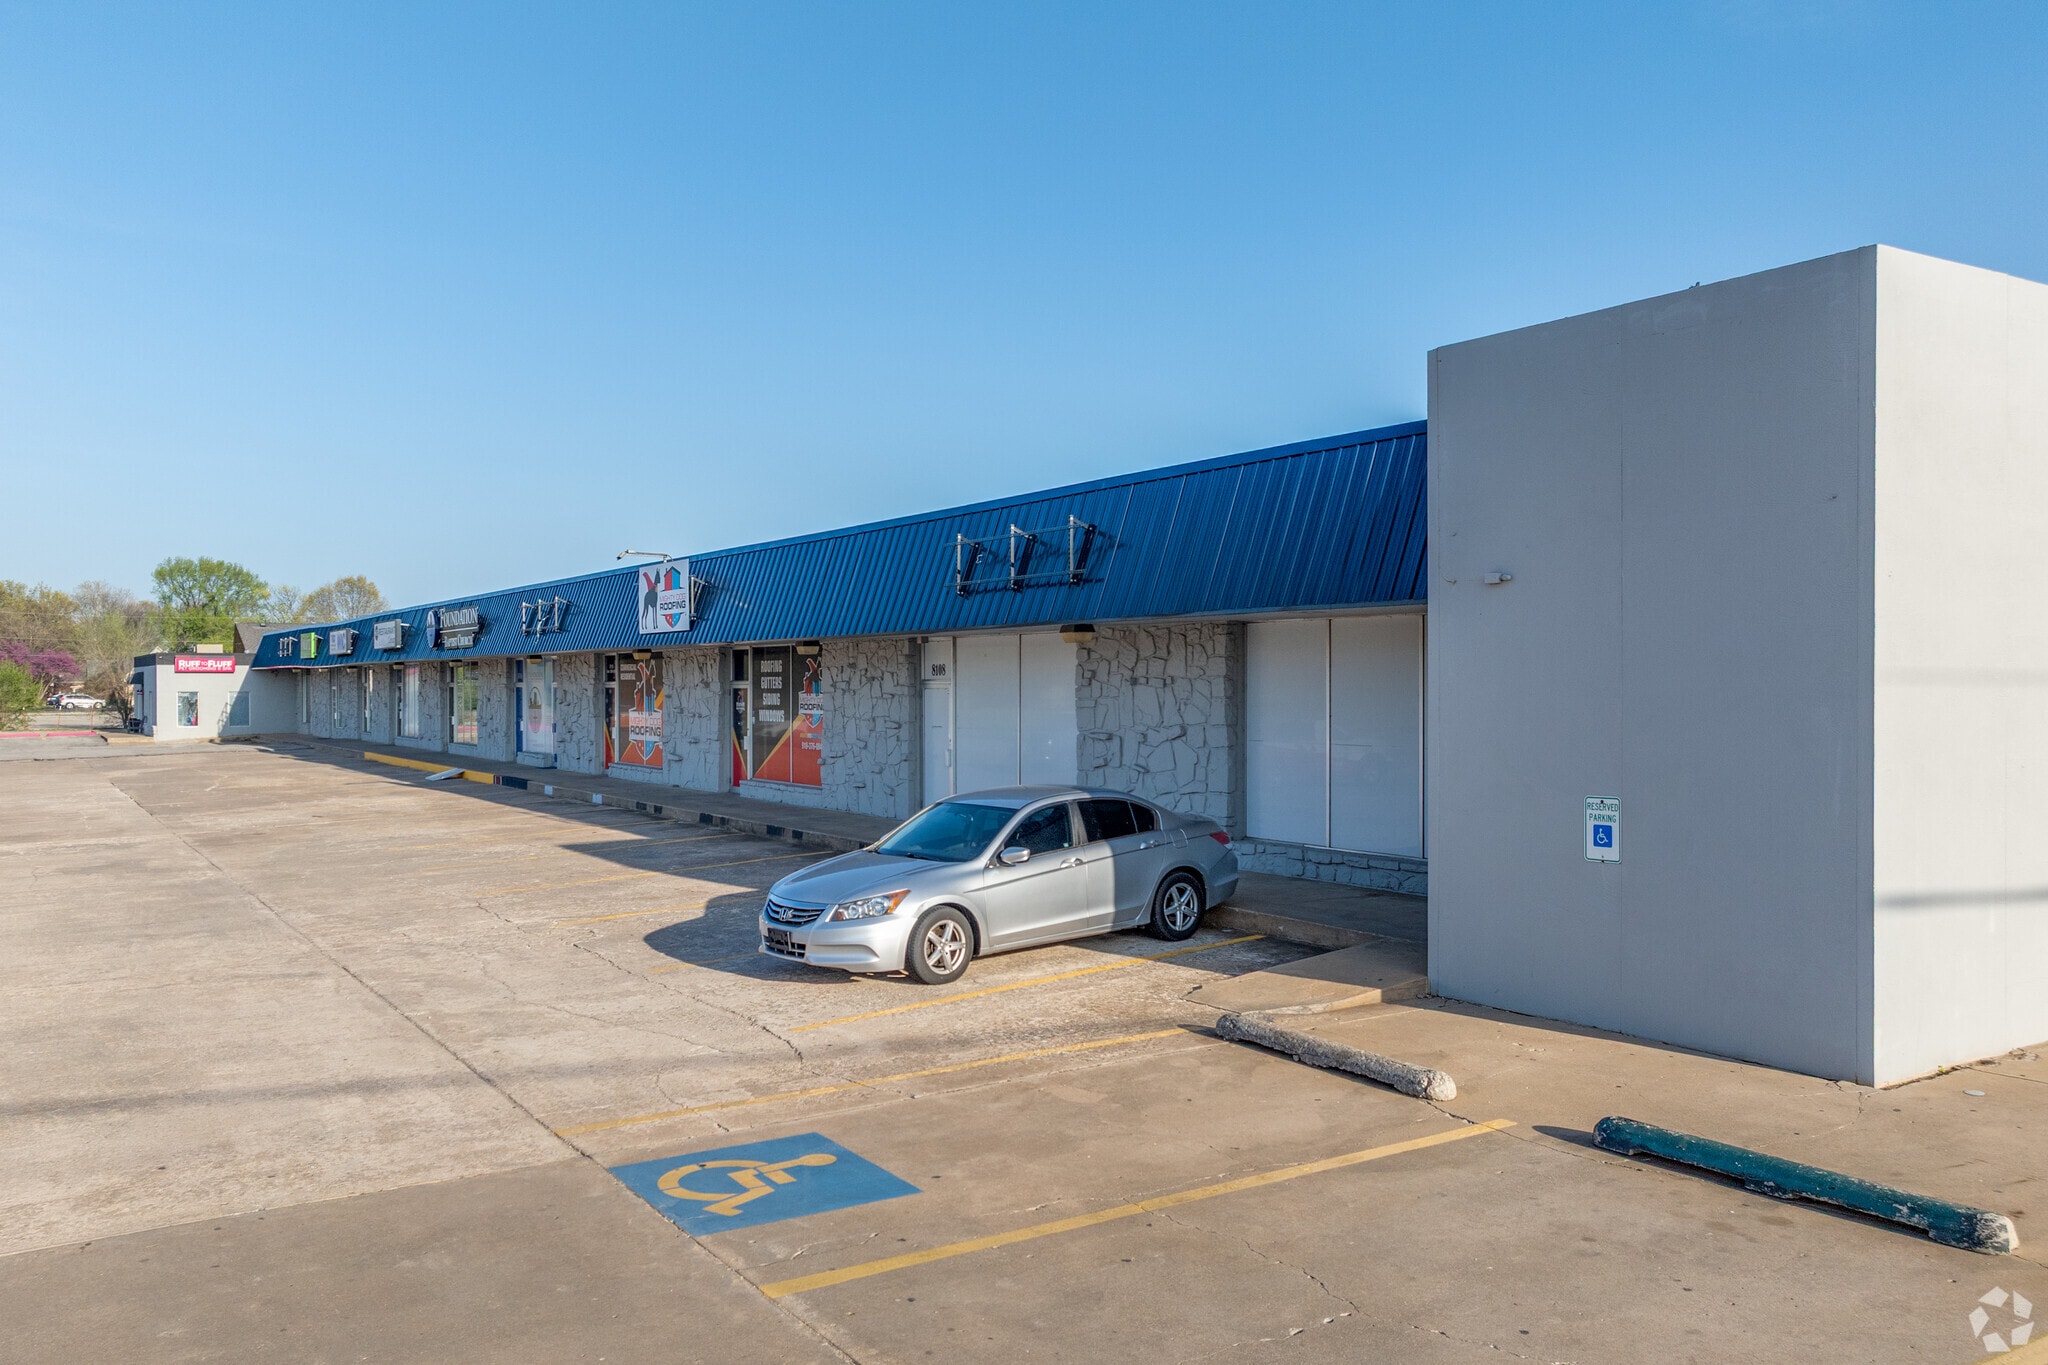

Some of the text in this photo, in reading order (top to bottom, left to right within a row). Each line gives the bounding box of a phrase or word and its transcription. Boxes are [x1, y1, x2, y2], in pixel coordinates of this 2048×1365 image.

[660, 600, 686, 611] ROOFING
[440, 606, 478, 627] FOUNDATION
[178, 660, 200, 668] RUFF
[208, 660, 232, 668] FLUFF
[761, 660, 782, 673] ROOFING
[931, 663, 946, 676] 8108
[761, 677, 782, 689] GUTTERS
[763, 693, 780, 706] SIDING
[800, 703, 823, 711] ROOFIN
[759, 709, 784, 722] WINDOWS
[630, 725, 661, 737] ROOFING
[1587, 802, 1619, 812] RESERVED
[1589, 813, 1616, 823] PARKING
